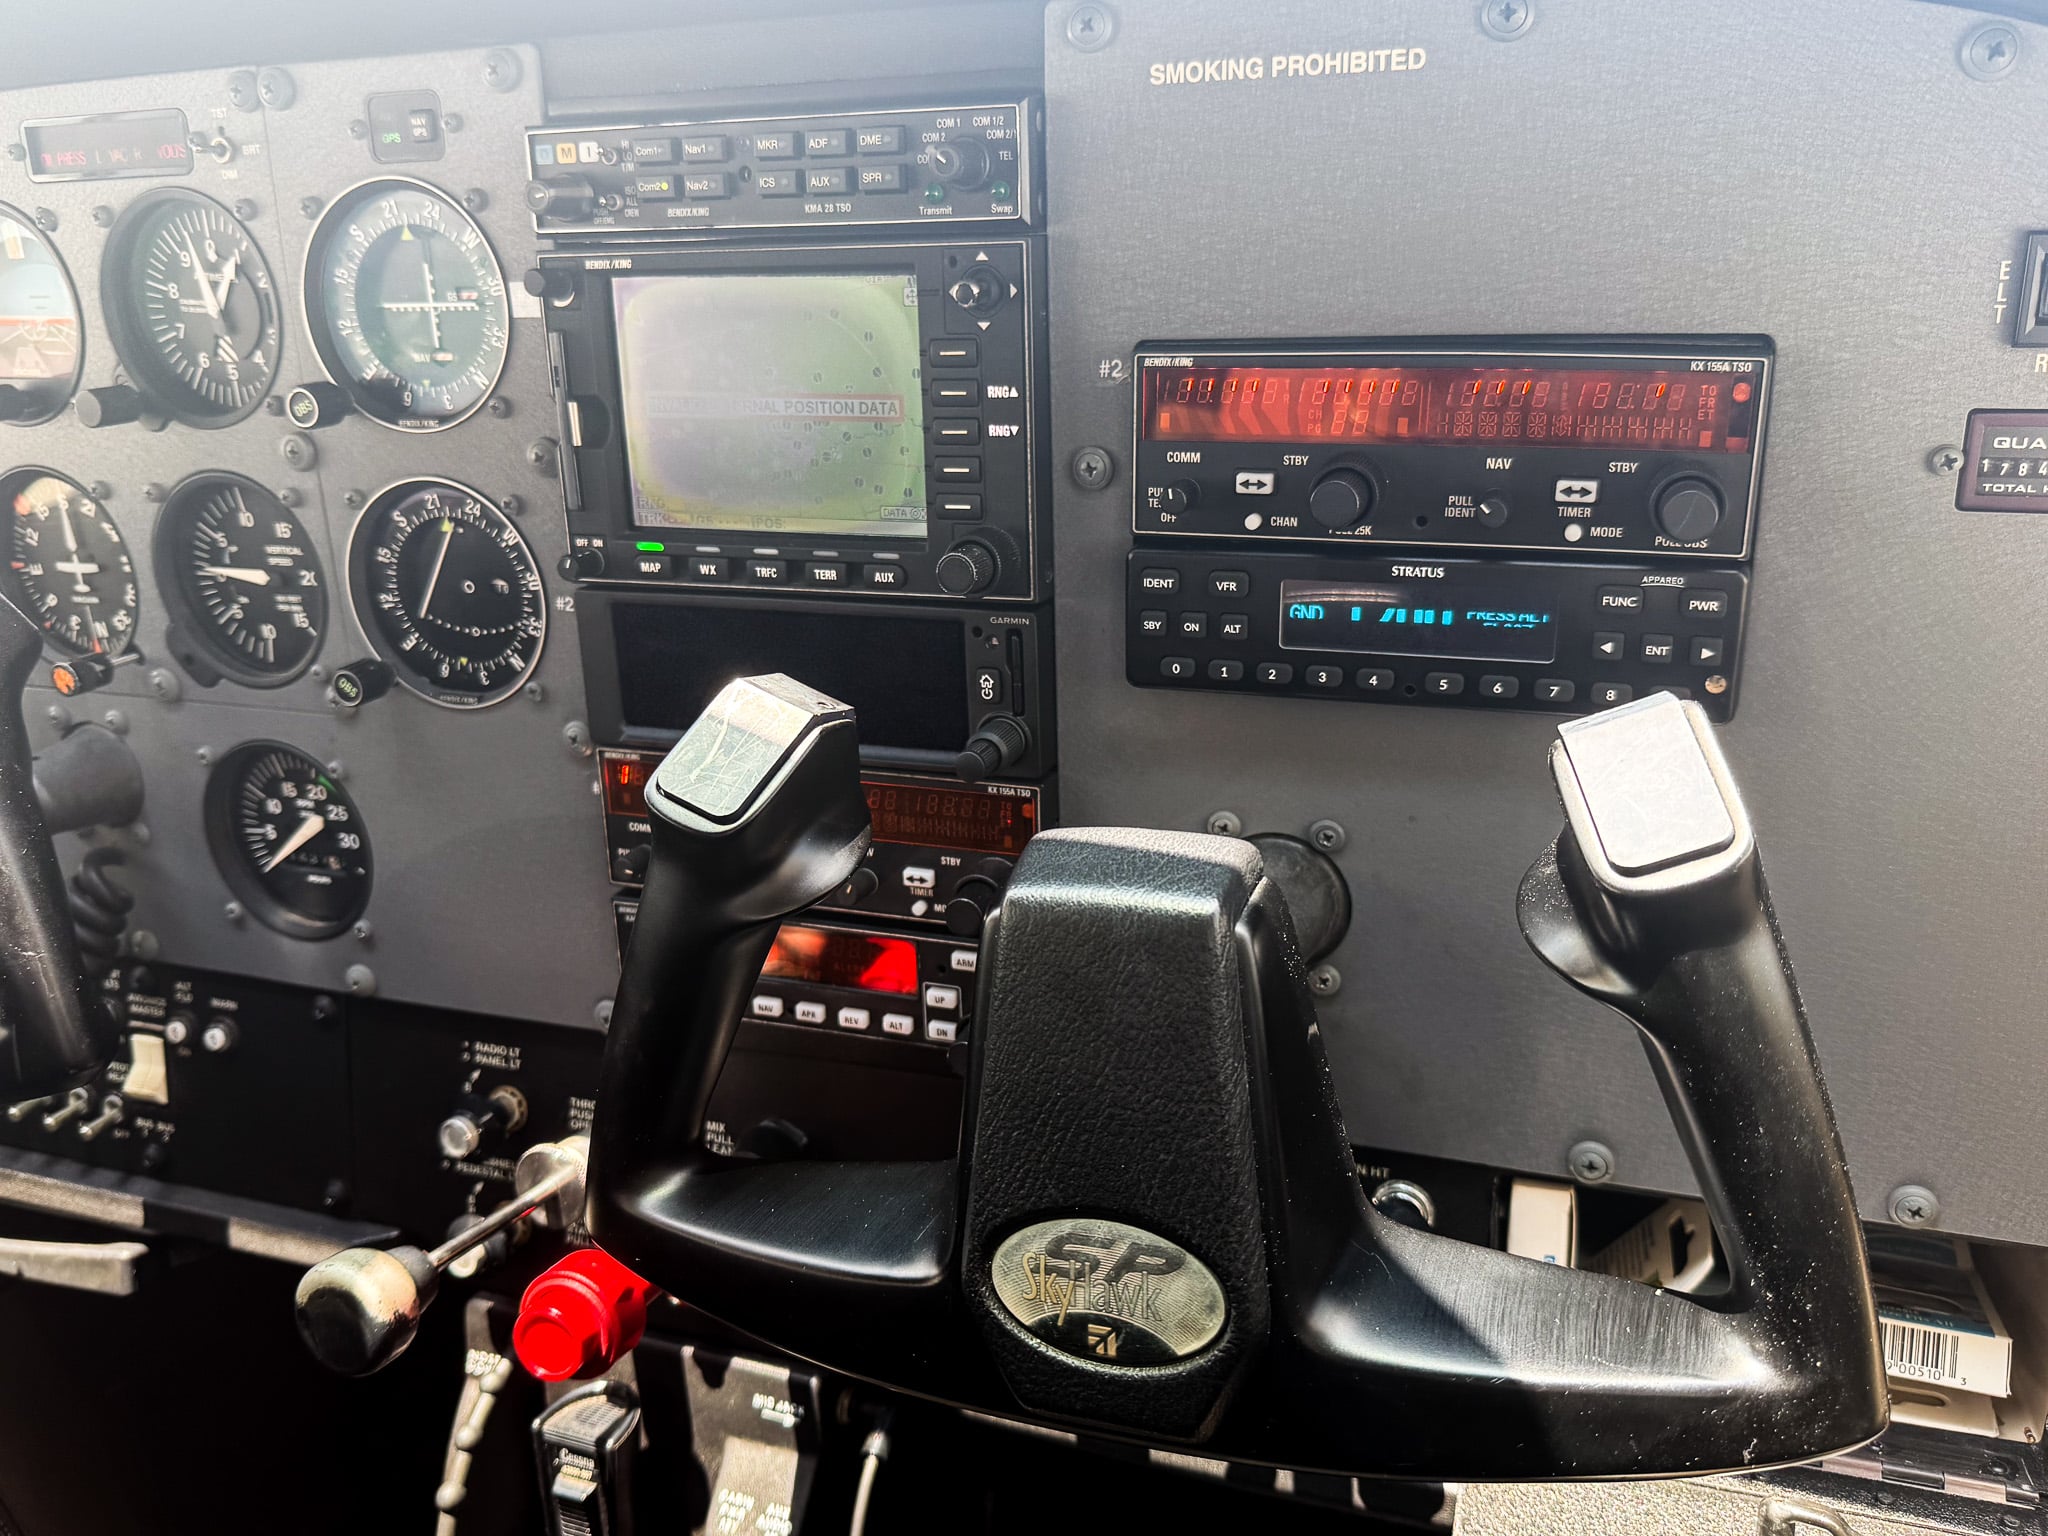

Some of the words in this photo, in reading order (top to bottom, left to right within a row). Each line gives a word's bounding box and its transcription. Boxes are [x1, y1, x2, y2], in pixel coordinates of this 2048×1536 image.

[1149, 57, 1264, 85] SMOKING
[1270, 47, 1427, 78] PROHIBITED
[936, 118, 955, 129] COM
[972, 117, 991, 127] COM
[992, 116, 1005, 126] 1/2
[382, 132, 402, 144] GPS
[859, 134, 883, 146] DME
[922, 133, 940, 143] COM
[940, 133, 946, 142] 2
[986, 129, 1004, 140] COM
[685, 144, 706, 154] Nav1
[757, 140, 779, 151] MKR
[808, 138, 829, 149] ADF
[561, 146, 573, 159] M
[636, 145, 659, 156] Com1
[998, 151, 1014, 161] TEL
[759, 177, 776, 188] ICS
[810, 176, 831, 187] AUX
[862, 173, 882, 183] SPR
[638, 182, 661, 192] Com2
[686, 181, 708, 191] Nav2
[382, 199, 399, 219] 21
[425, 201, 442, 221] 24
[667, 207, 710, 218] BENDIX/KING
[805, 203, 824, 214] KMA
[824, 203, 834, 213] 28
[835, 203, 852, 213] TSO
[919, 206, 953, 216] Transmit
[991, 204, 1014, 216] Swap
[180, 250, 192, 268] 9
[585, 259, 633, 270] BENDIX/KING
[257, 270, 269, 289] 2
[333, 267, 350, 285] 15
[168, 282, 180, 299] 8
[1993, 260, 2012, 325] ELT
[174, 322, 186, 339] 7
[338, 319, 356, 338] 12
[198, 351, 210, 369] 6
[253, 350, 266, 364] 4
[1144, 357, 1194, 368] BENDIX/KING
[227, 363, 238, 380] 5
[1099, 360, 1123, 377] #2
[1690, 361, 1705, 372] KX
[1706, 361, 1732, 373] 155A
[1732, 362, 1752, 373] TSO
[987, 386, 1009, 399] RNG
[293, 400, 314, 417] OBS
[784, 400, 856, 416] POSITION
[858, 400, 899, 416] DATA
[988, 425, 1011, 437] RNG
[1166, 451, 1201, 463] COMM
[1283, 455, 1309, 466] STBY
[1486, 458, 1512, 470] NAV
[1608, 461, 1638, 473] STBY
[1982, 483, 2037, 494] TOTAL
[424, 493, 441, 511] 21
[1448, 495, 1474, 507] PULL
[466, 498, 482, 518] 24
[883, 507, 908, 518] DATA
[1444, 506, 1477, 518] IDENT
[1557, 506, 1592, 518] TIMER
[239, 511, 255, 528] 10
[391, 510, 407, 529] S
[1270, 517, 1298, 527] CHAN
[275, 522, 292, 539] 15
[1590, 526, 1623, 538] MODE
[576, 538, 588, 547] OFF
[592, 538, 603, 548] ON
[375, 546, 393, 564] 15
[641, 562, 662, 573] MAP
[699, 564, 717, 576] WX
[755, 567, 778, 579] TRFC
[1391, 565, 1445, 578] STRATUS
[813, 569, 837, 581] TERR
[874, 572, 895, 583] AUX
[1641, 575, 1685, 586] APPAREO
[1143, 578, 1174, 589] IDENT
[1216, 581, 1237, 592] VFR
[379, 591, 395, 611] 12
[555, 596, 576, 612] #2
[1602, 595, 1638, 607] FUNC
[1688, 599, 1719, 612] PWR
[989, 616, 1030, 625] GARMIN
[1143, 620, 1162, 631] SBY
[260, 623, 277, 640] 10
[1183, 622, 1200, 633] ON
[1223, 623, 1242, 634] ALT
[1645, 645, 1670, 656] ENT
[1172, 663, 1181, 675] 0
[1220, 667, 1228, 678] 1
[1268, 669, 1276, 681] 2
[1318, 671, 1327, 683] 3
[1368, 675, 1378, 686] 4
[338, 677, 359, 698] OBS
[1439, 679, 1449, 691] 5
[1492, 682, 1502, 694] 6
[1549, 686, 1560, 698] 7
[1605, 689, 1615, 701] 8
[282, 781, 298, 798] 15
[307, 784, 328, 801] 20
[988, 786, 998, 795] KX
[999, 787, 1016, 796] 155A
[1016, 788, 1031, 798] TSO
[327, 805, 349, 821] 25
[338, 832, 360, 850] 30
[940, 856, 962, 867] STBY
[909, 886, 934, 897] TIMER
[956, 958, 975, 968] ARM
[934, 996, 946, 1004] UP
[757, 1004, 774, 1013] NAV
[844, 1015, 859, 1025] REV
[889, 1021, 904, 1031] ALT
[936, 1028, 948, 1037] DN
[475, 1042, 508, 1055] RADIO
[474, 1054, 509, 1067] PANEL
[706, 1120, 726, 1132] MIX
[706, 1131, 734, 1145] PULL
[1022, 1252, 1164, 1327] SkyHawk
[1960, 1376, 1967, 1386] 3
